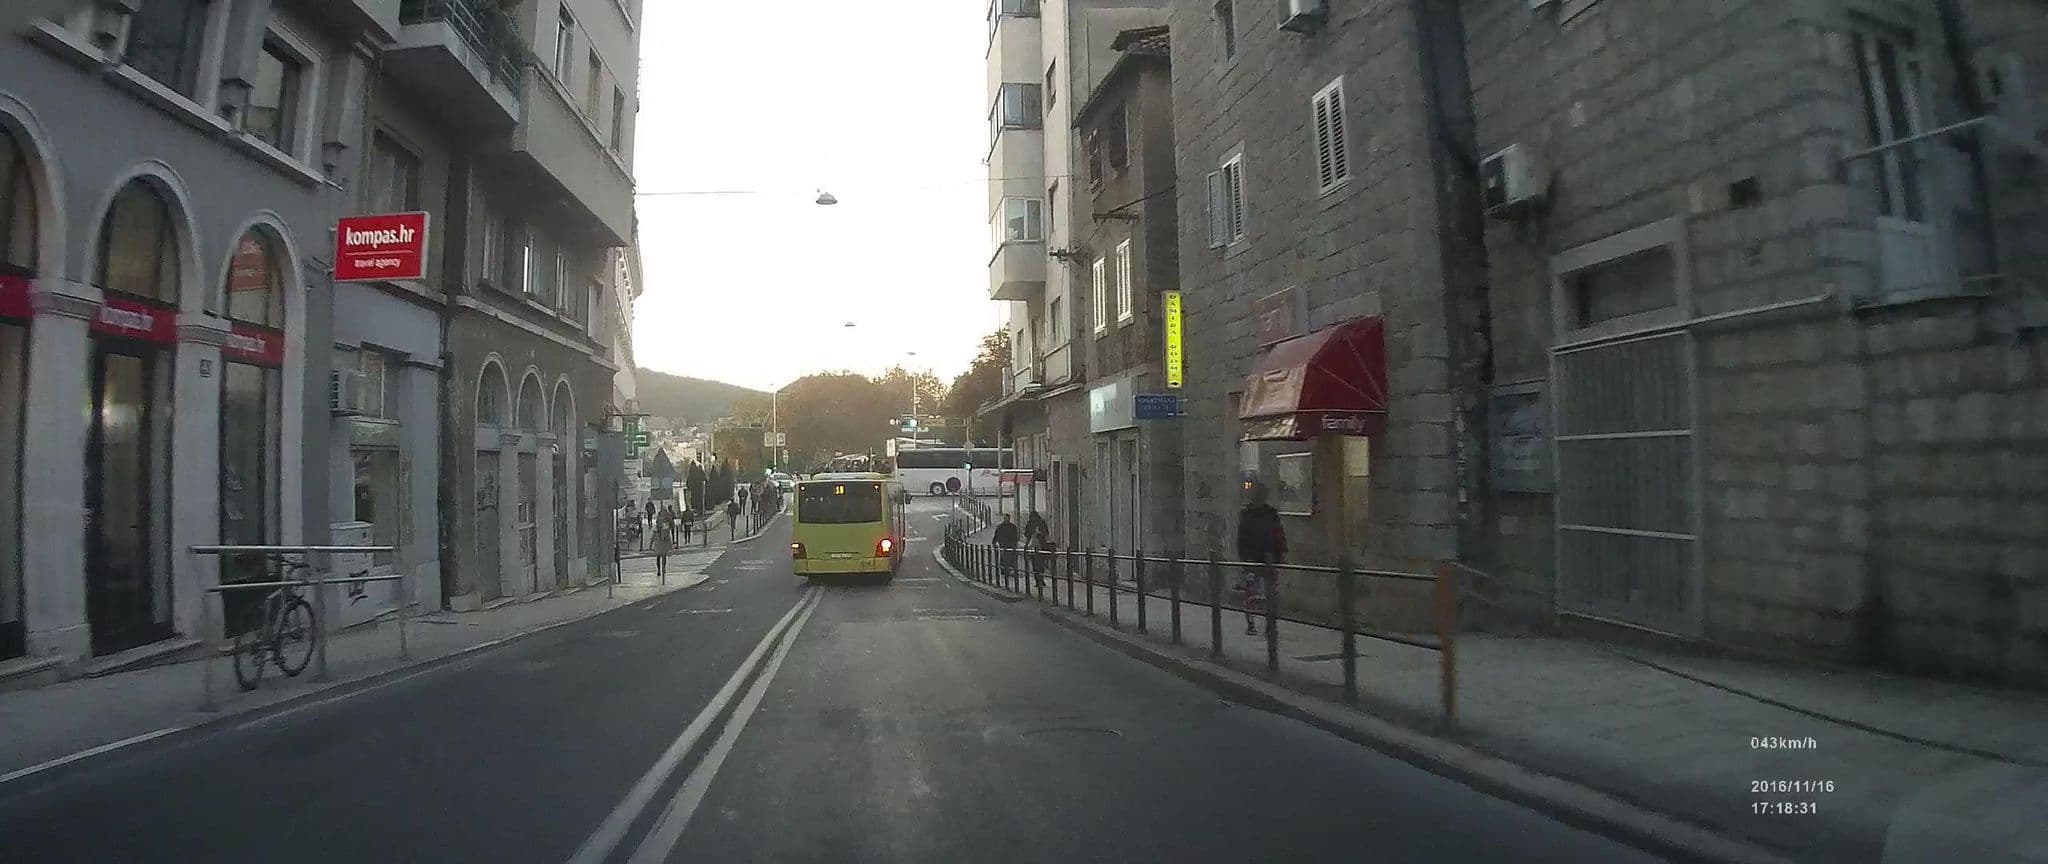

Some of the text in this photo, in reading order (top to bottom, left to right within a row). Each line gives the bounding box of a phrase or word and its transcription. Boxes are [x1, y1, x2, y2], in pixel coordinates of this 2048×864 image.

[345, 224, 415, 249] kompas.hr
[375, 257, 401, 269] agency
[1322, 414, 1368, 433] family
